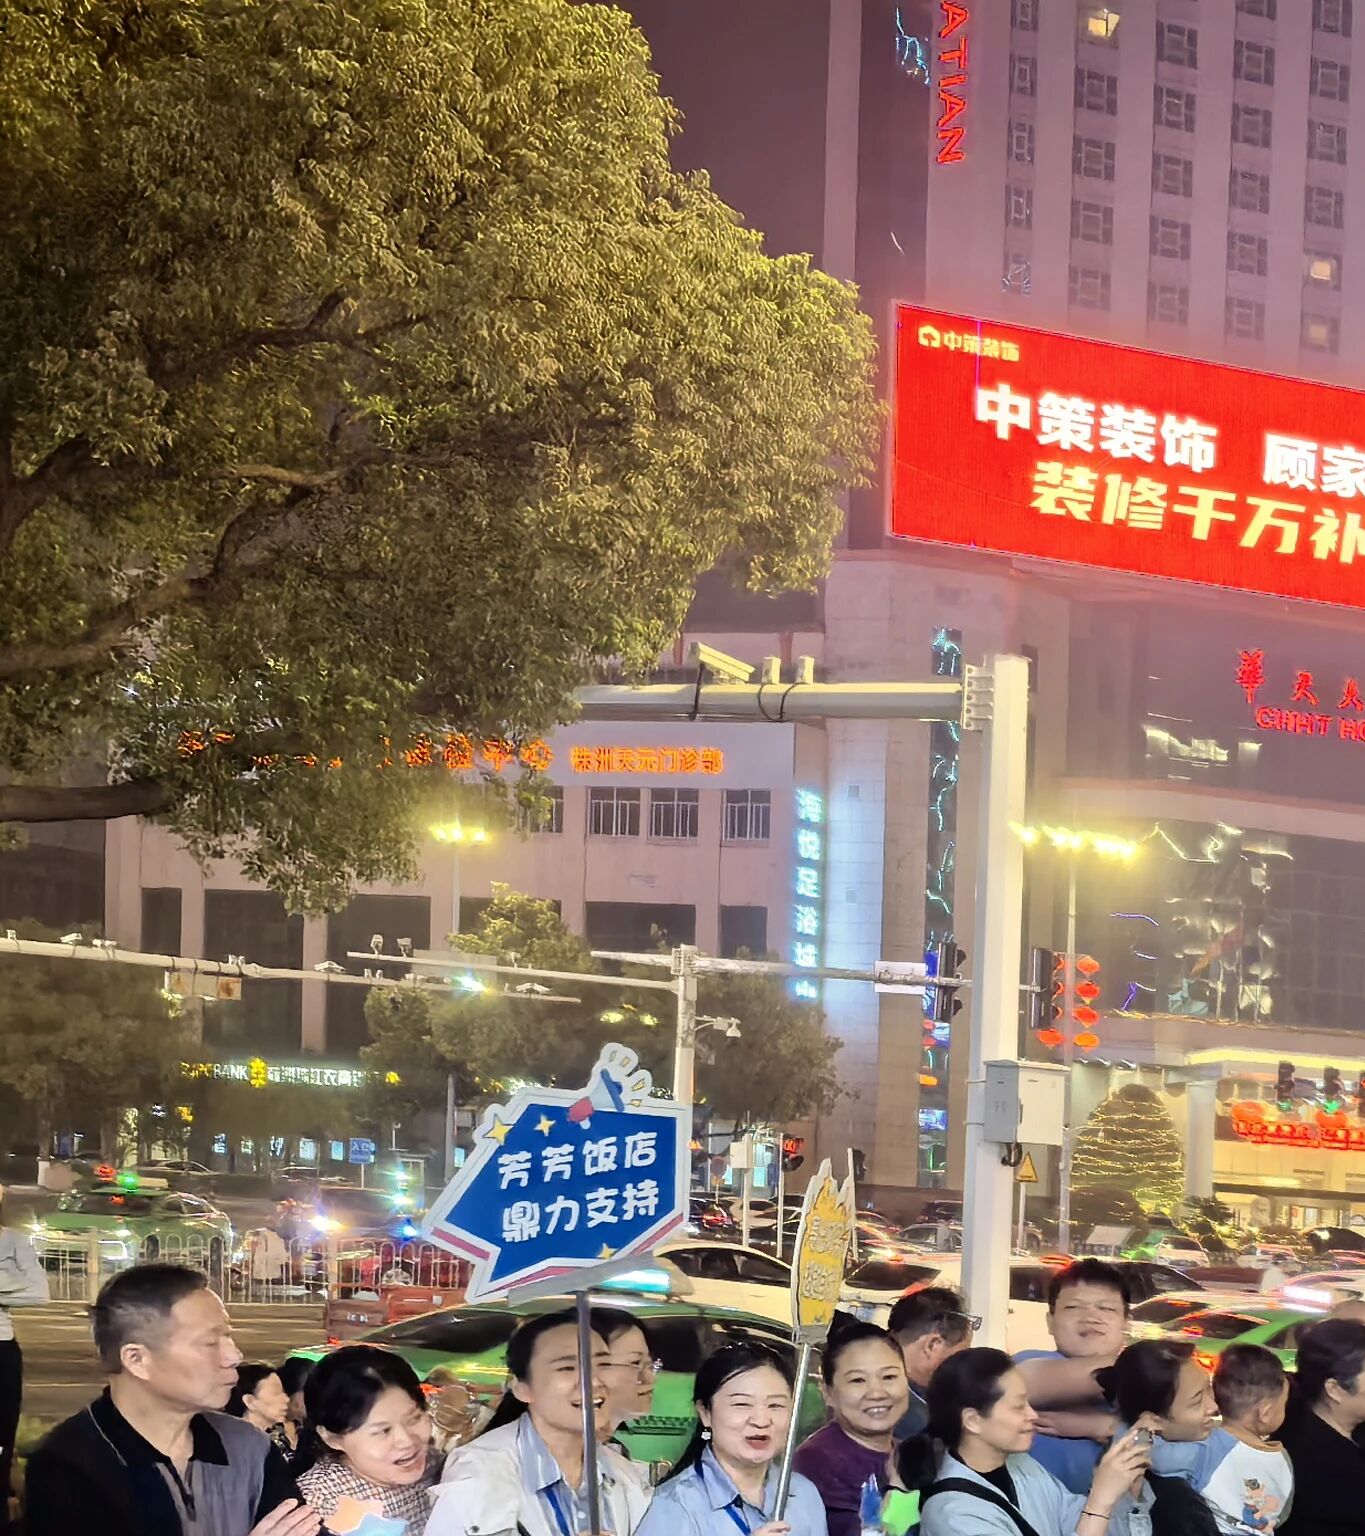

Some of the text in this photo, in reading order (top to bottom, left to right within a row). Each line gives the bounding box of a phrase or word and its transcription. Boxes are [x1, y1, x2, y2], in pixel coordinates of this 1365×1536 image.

[943, 330, 1020, 363] 中策装饰
[975, 383, 1218, 473] 中策装饰
[571, 746, 724, 775] 株洲天元门诊部
[498, 1131, 658, 1189] 芳芳饭店
[502, 1179, 659, 1242] 鼎力支持
